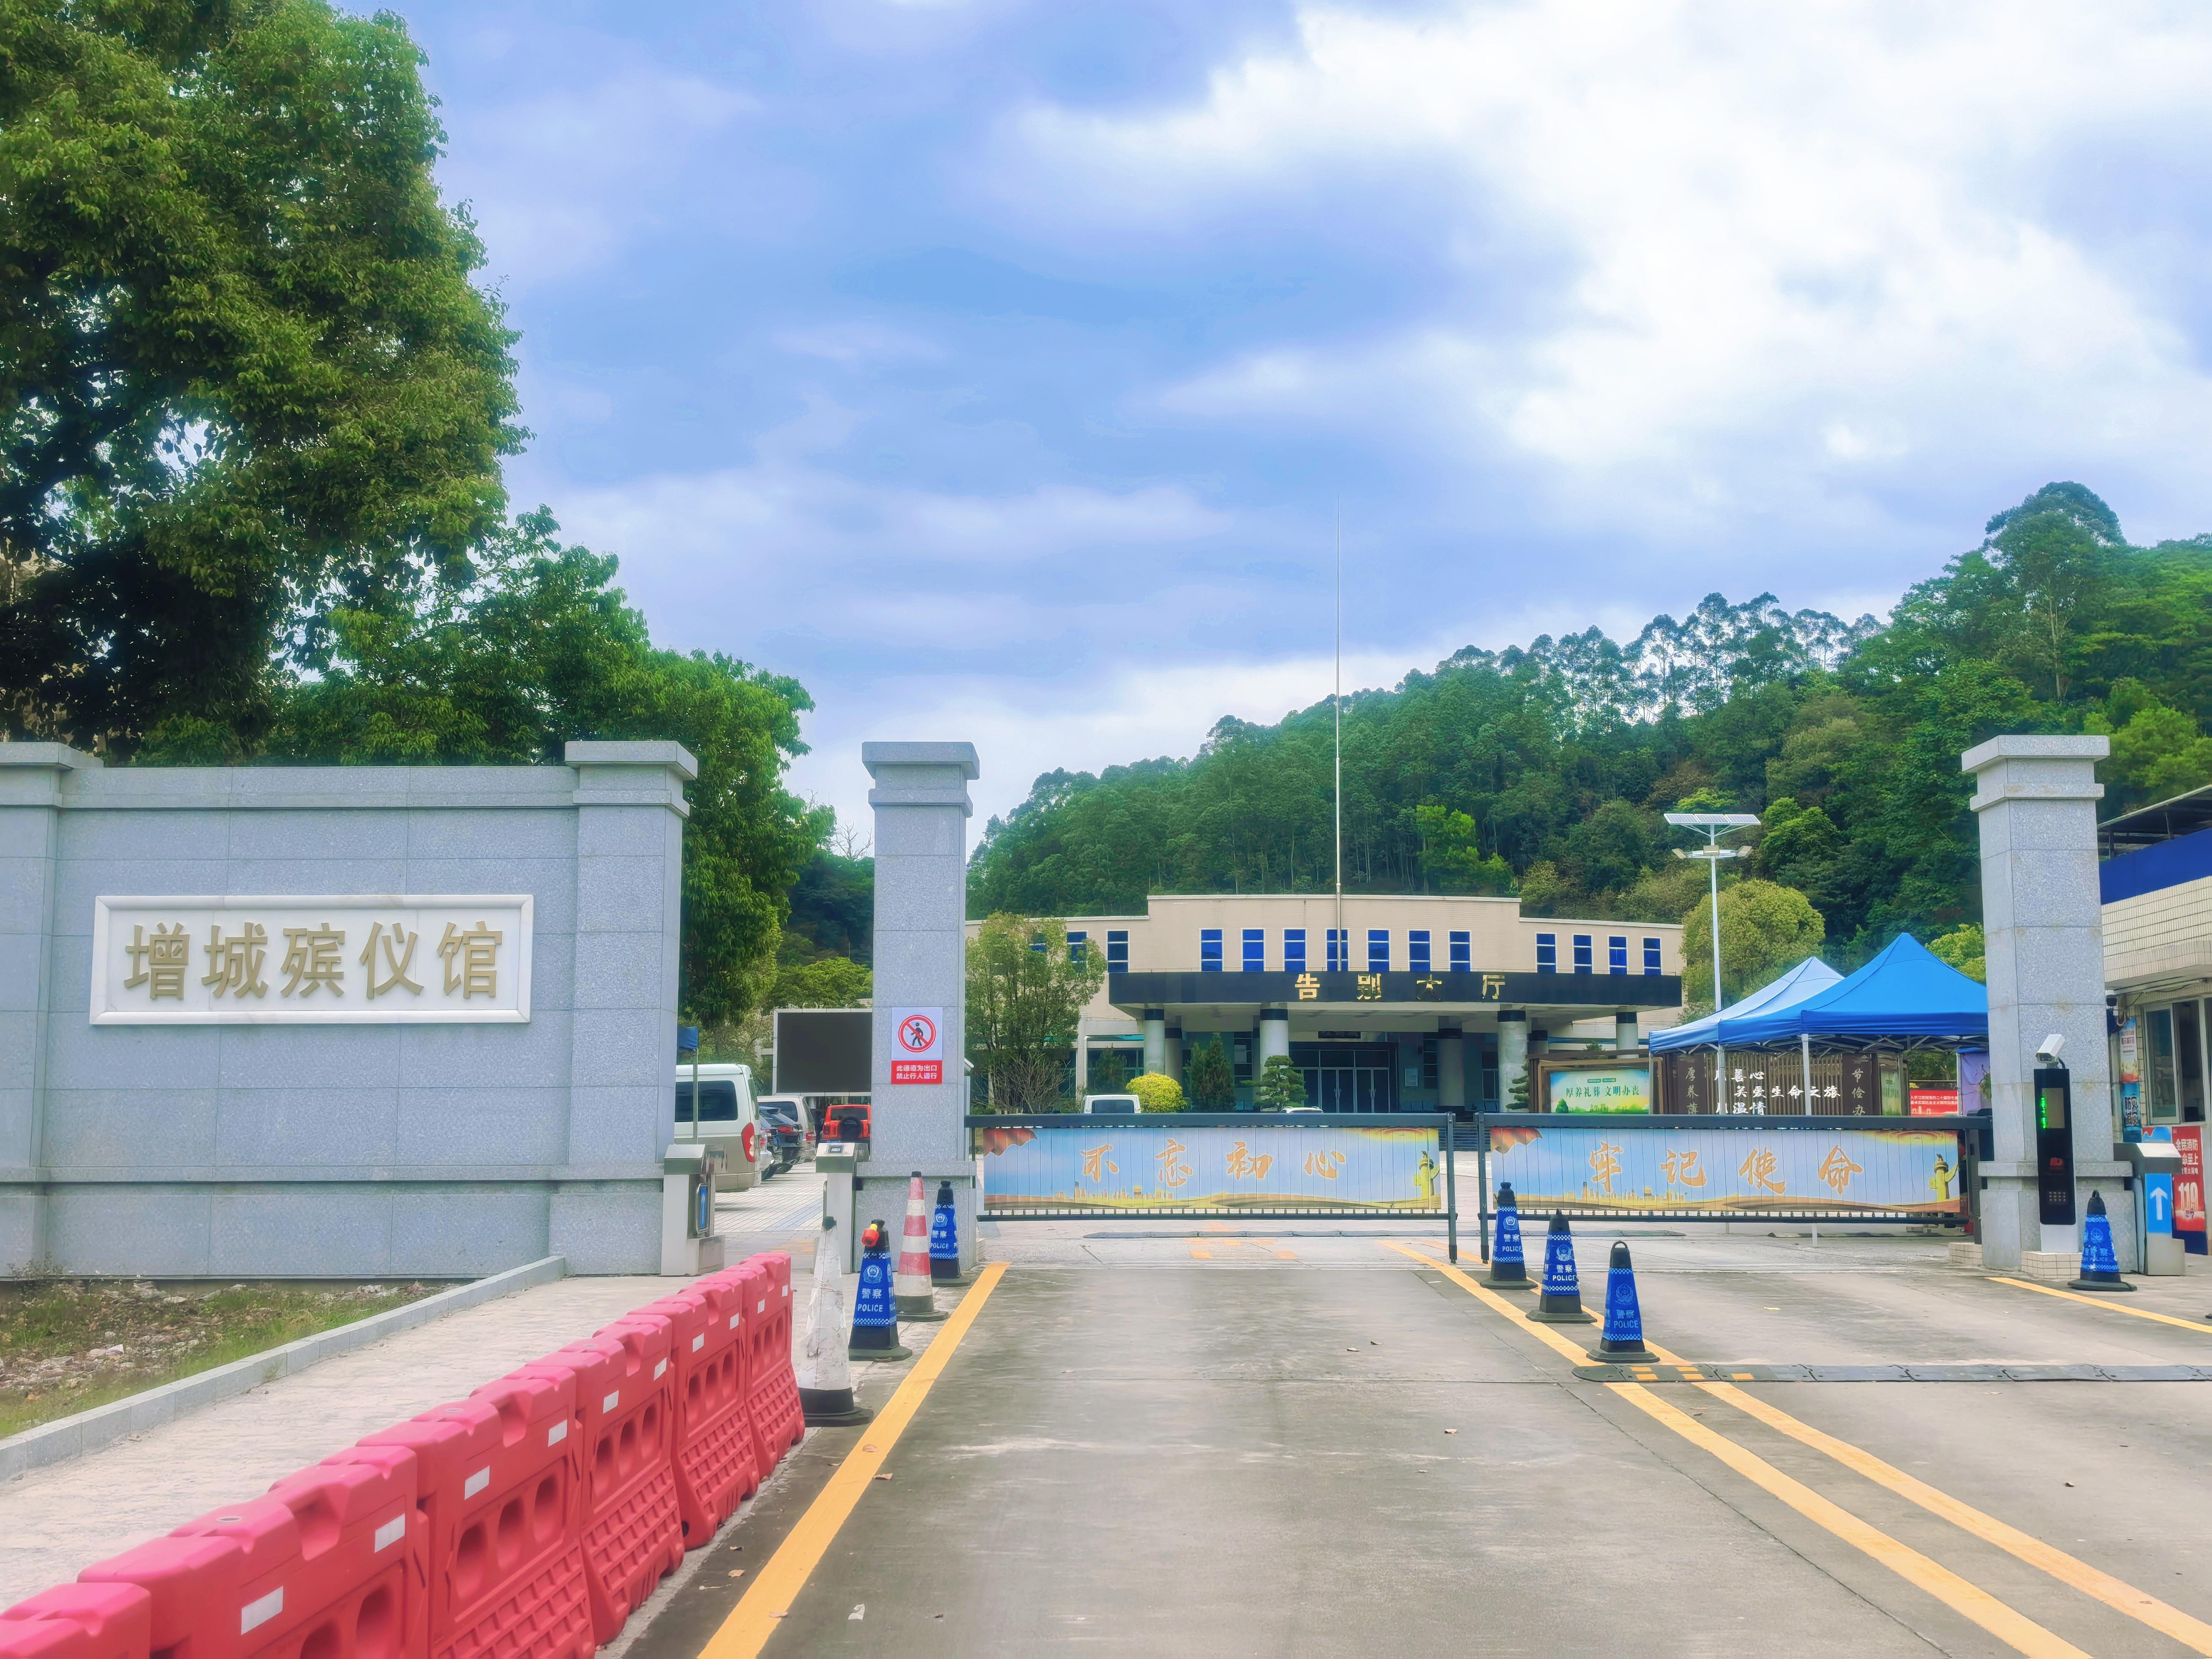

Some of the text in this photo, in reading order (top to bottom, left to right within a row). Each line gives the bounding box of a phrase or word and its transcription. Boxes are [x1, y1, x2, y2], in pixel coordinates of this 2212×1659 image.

[123, 921, 503, 999] 增城殡仪馆
[1294, 973, 1505, 1001] 告别大厅
[1566, 1085, 1639, 1098] 厚养礼葬 文明办丧
[1734, 1085, 1841, 1099] 关爱生命之旅
[1852, 1068, 1865, 1116] 节俭办
[2176, 1139, 2198, 1151] 全民消防
[1081, 1139, 1345, 1187] 不忘初心
[2182, 1152, 2198, 1165] 命至上
[1589, 1142, 1863, 1194] 牢记使命
[2178, 1182, 2198, 1212] 119
[932, 1230, 947, 1238] 警察
[1556, 1264, 1572, 1273] 警察
[861, 1288, 882, 1299] 警察
[858, 1304, 883, 1312] POLICE
[1616, 1310, 1634, 1319] 警察
[1613, 1320, 1638, 1329] POLICE
